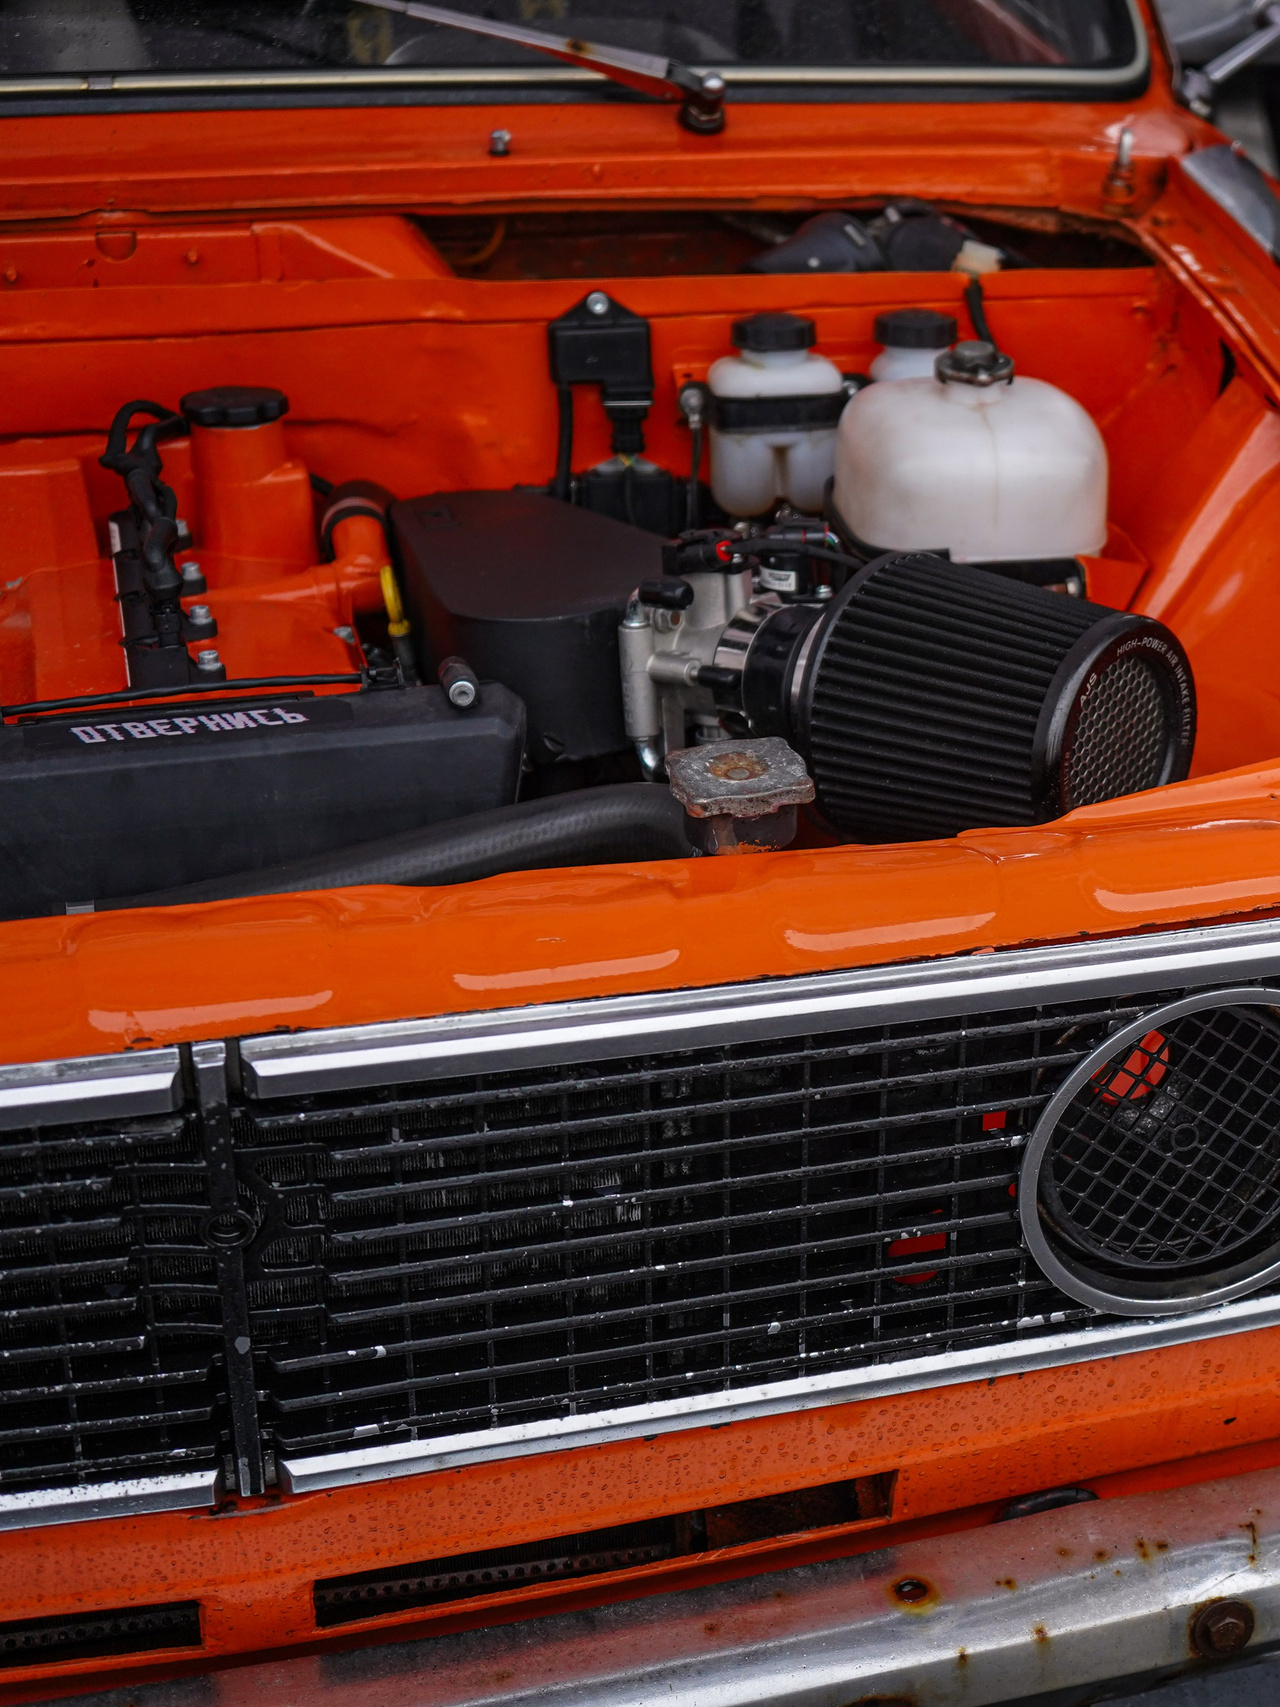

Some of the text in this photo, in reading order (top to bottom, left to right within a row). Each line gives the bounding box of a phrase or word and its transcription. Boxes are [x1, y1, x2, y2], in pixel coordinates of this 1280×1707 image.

[1116, 636, 1168, 657] HIGH-POWER
[1165, 649, 1179, 667] AIR
[1080, 672, 1097, 707] AJS
[69, 708, 309, 744] ОТВЕРНИСЬ
